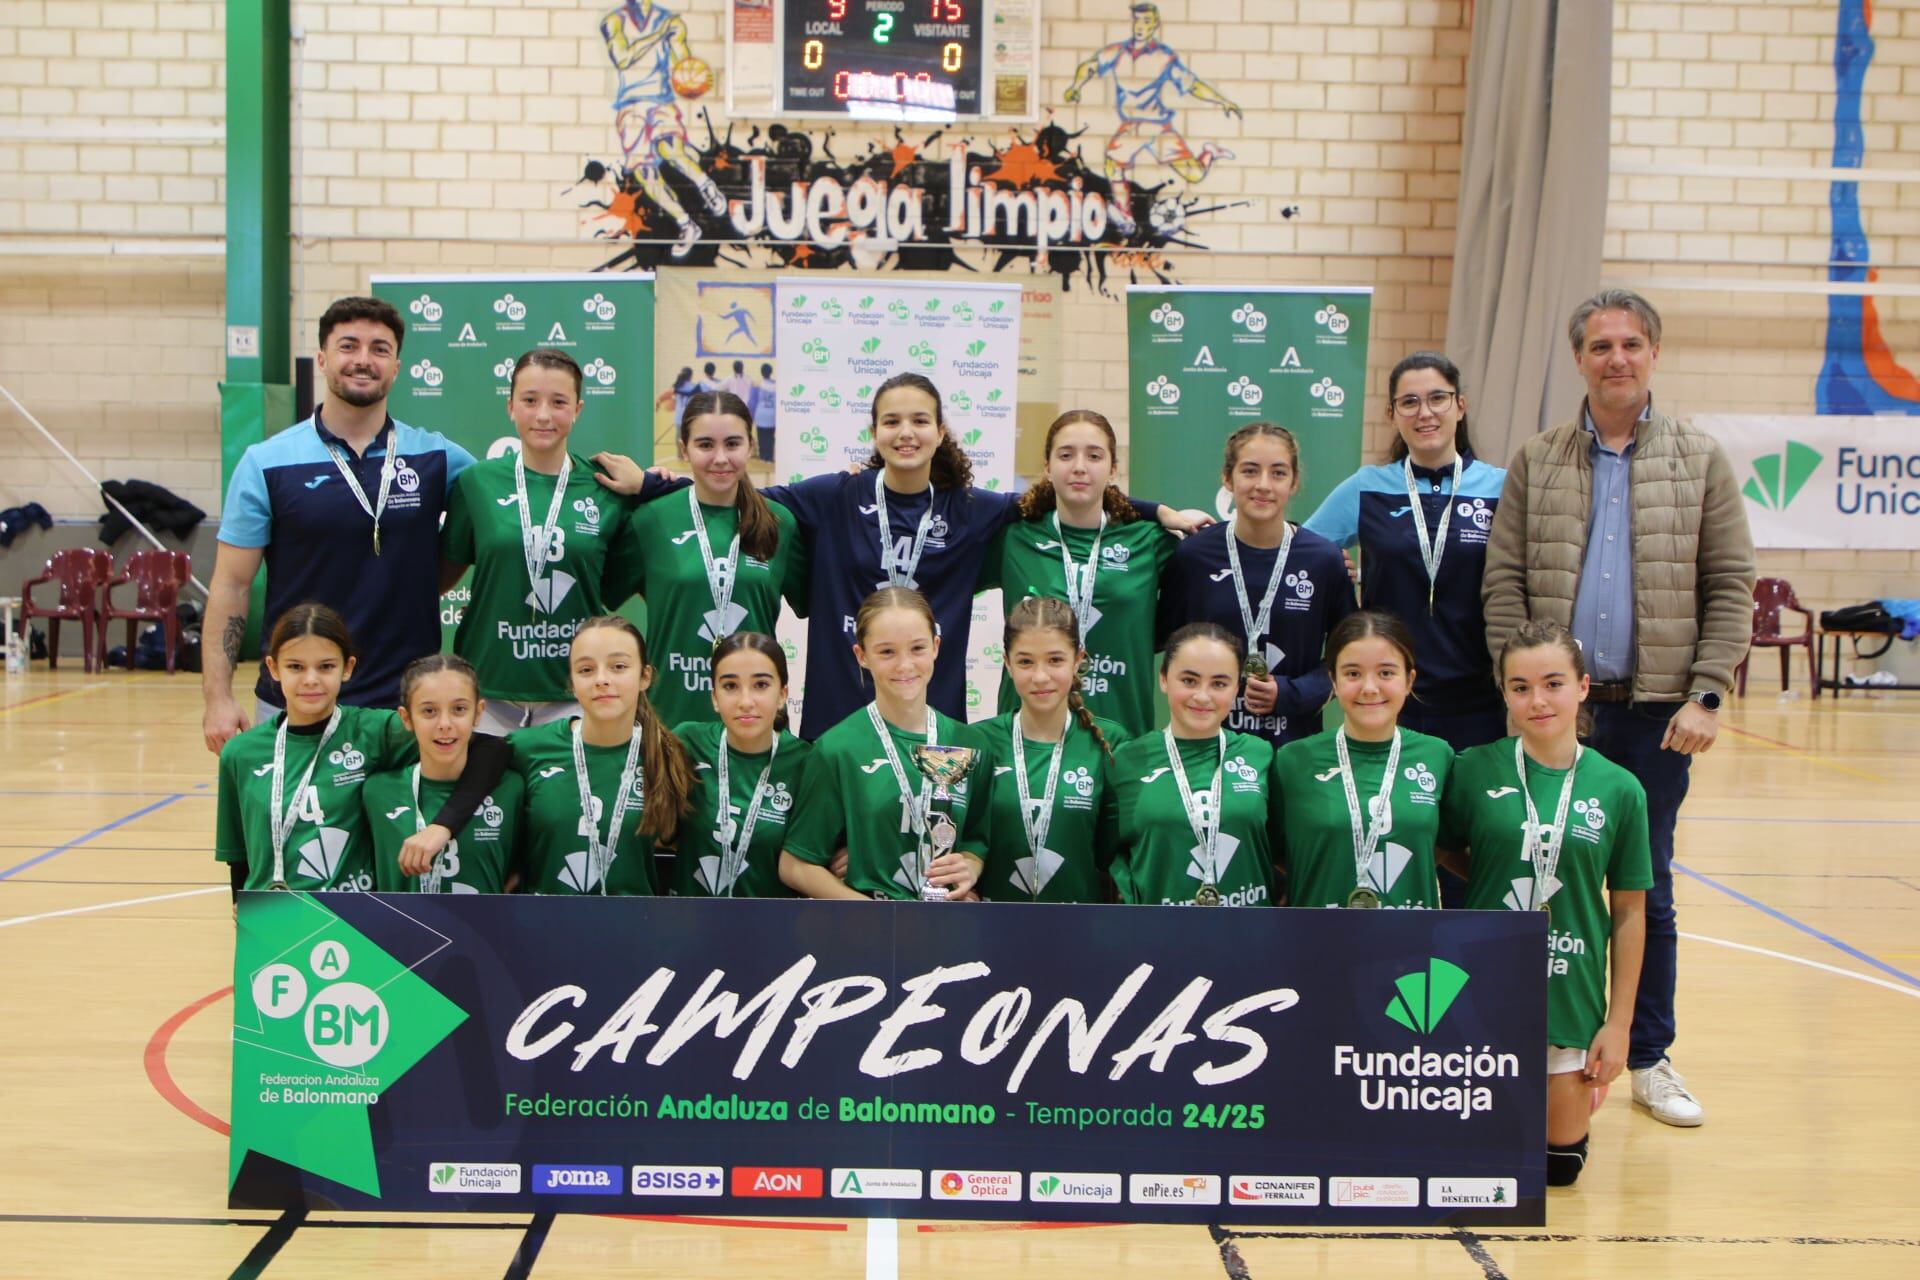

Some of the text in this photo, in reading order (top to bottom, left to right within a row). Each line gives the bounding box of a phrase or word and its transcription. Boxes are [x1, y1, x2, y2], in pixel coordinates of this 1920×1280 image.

[866, 1, 904, 12] PERIODO
[805, 21, 844, 35] LOCAL
[873, 13, 894, 43] 2
[914, 23, 970, 38] VISITANTE
[804, 40, 823, 69] 0
[943, 42, 962, 72] 0
[809, 87, 825, 96] OUT
[728, 143, 1107, 265] Juega limpio
[847, 357, 894, 366] Fundación
[952, 359, 999, 369] Fundación
[854, 366, 888, 376] Unicaja
[958, 368, 992, 379] Unicaja
[400, 473, 418, 486] BM
[1475, 512, 1494, 525] BM
[1298, 583, 1313, 594] BM
[345, 754, 363, 767] BM
[1241, 769, 1257, 778] BM
[1078, 781, 1093, 791] BM
[1420, 776, 1435, 787] BM
[298, 785, 325, 825] 4
[774, 796, 790, 806] BM
[486, 811, 502, 821] BM
[1588, 812, 1604, 823] BM
[713, 805, 742, 843] 5
[440, 838, 460, 878] 3
[271, 947, 379, 1046] F A BM
[505, 953, 1299, 1093] CAMPEONAS
[1334, 1045, 1519, 1077] Fundación
[259, 1073, 379, 1087] Federacion Andaluza
[259, 1088, 379, 1104] de Balonmano
[1360, 1079, 1493, 1120] Unicaja
[505, 1092, 649, 1118] Federación
[657, 1093, 788, 1121] Andaluza
[798, 1097, 830, 1120] de
[839, 1096, 995, 1124] Balonmano
[1025, 1101, 1173, 1131] Temporada
[1182, 1103, 1265, 1129] 24/25
[459, 1166, 518, 1178] Fundación
[459, 1177, 501, 1189] Unicaja
[753, 1171, 801, 1191] AON
[967, 1174, 1012, 1185] General
[1255, 1181, 1315, 1191] CONANIFER
[971, 1184, 1008, 1196] Optica
[1063, 1182, 1113, 1199] Unicaja
[1142, 1182, 1184, 1198] enPie.es
[1264, 1192, 1304, 1200] FERRALLA
